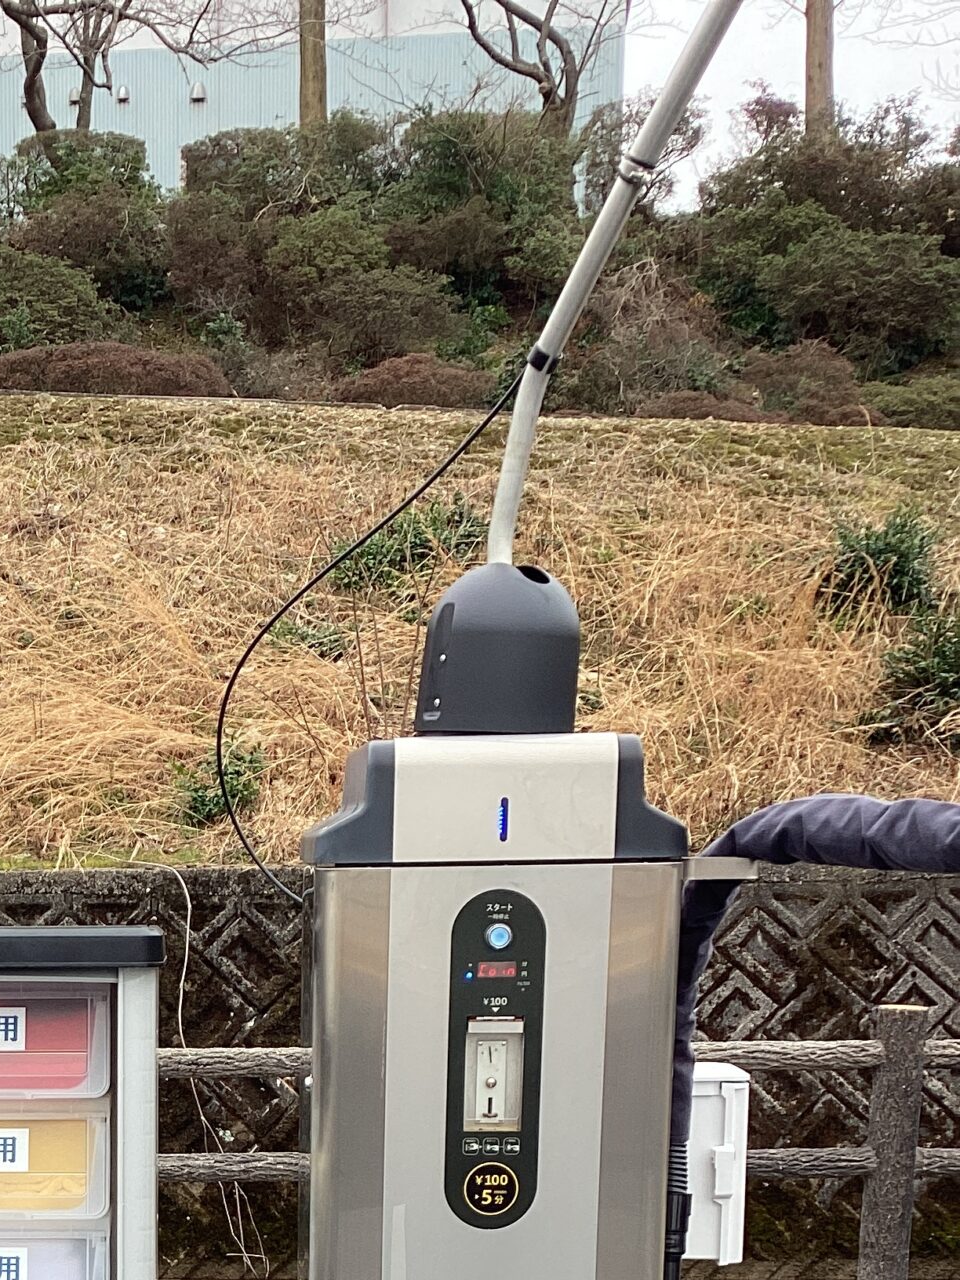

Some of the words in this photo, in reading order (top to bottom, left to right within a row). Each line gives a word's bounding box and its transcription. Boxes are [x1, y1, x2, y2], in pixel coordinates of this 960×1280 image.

[486, 903, 513, 912] スタート
[483, 997, 508, 1006] ¥100
[475, 1174, 509, 1186] ¥100
